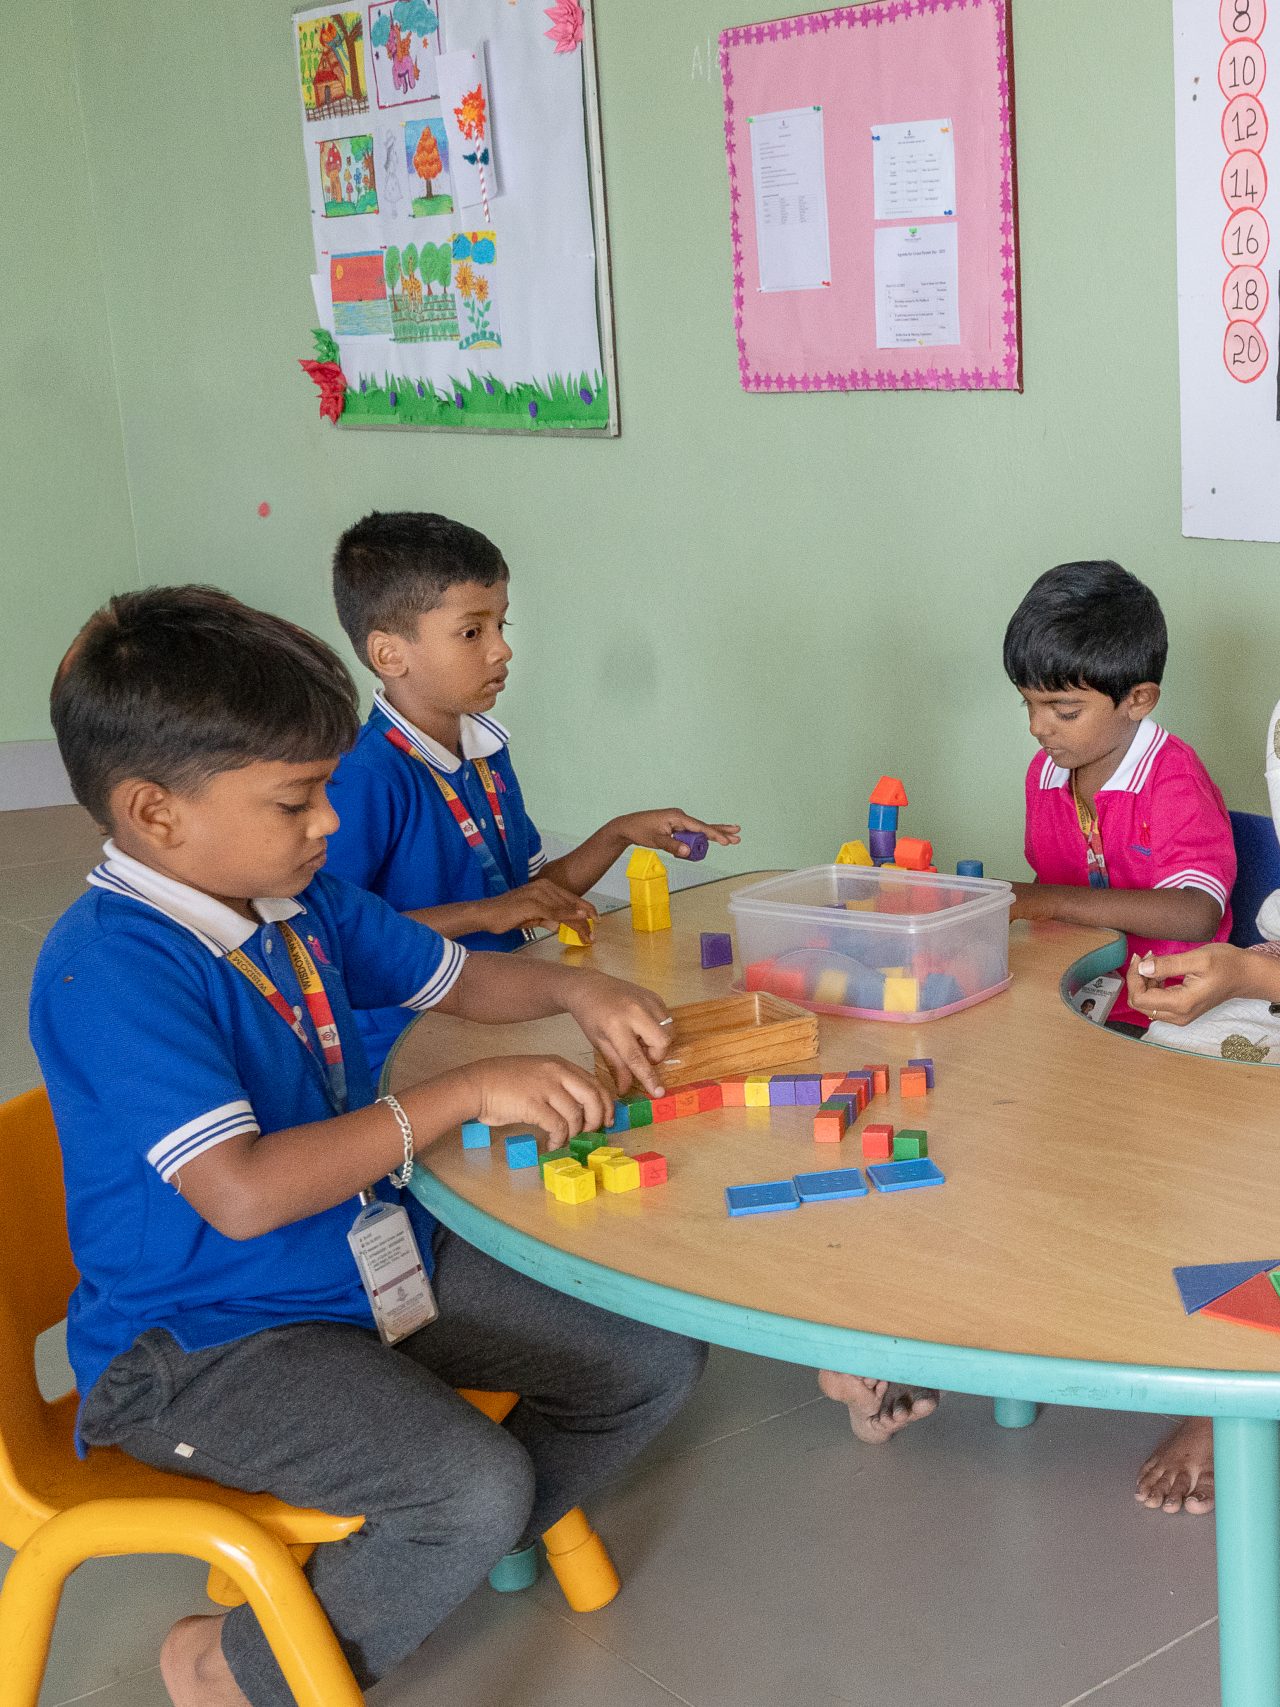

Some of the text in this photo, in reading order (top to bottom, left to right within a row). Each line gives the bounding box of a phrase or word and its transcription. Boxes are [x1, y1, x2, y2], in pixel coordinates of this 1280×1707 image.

[1233, 0, 1251, 32] 8
[1229, 56, 1256, 88] 10
[1232, 108, 1258, 142] 12
[1230, 169, 1258, 203] 14
[1232, 224, 1259, 255] 16
[1232, 279, 1259, 311] 18
[1233, 334, 1261, 365] 20
[293, 951, 312, 990] WISDOM
